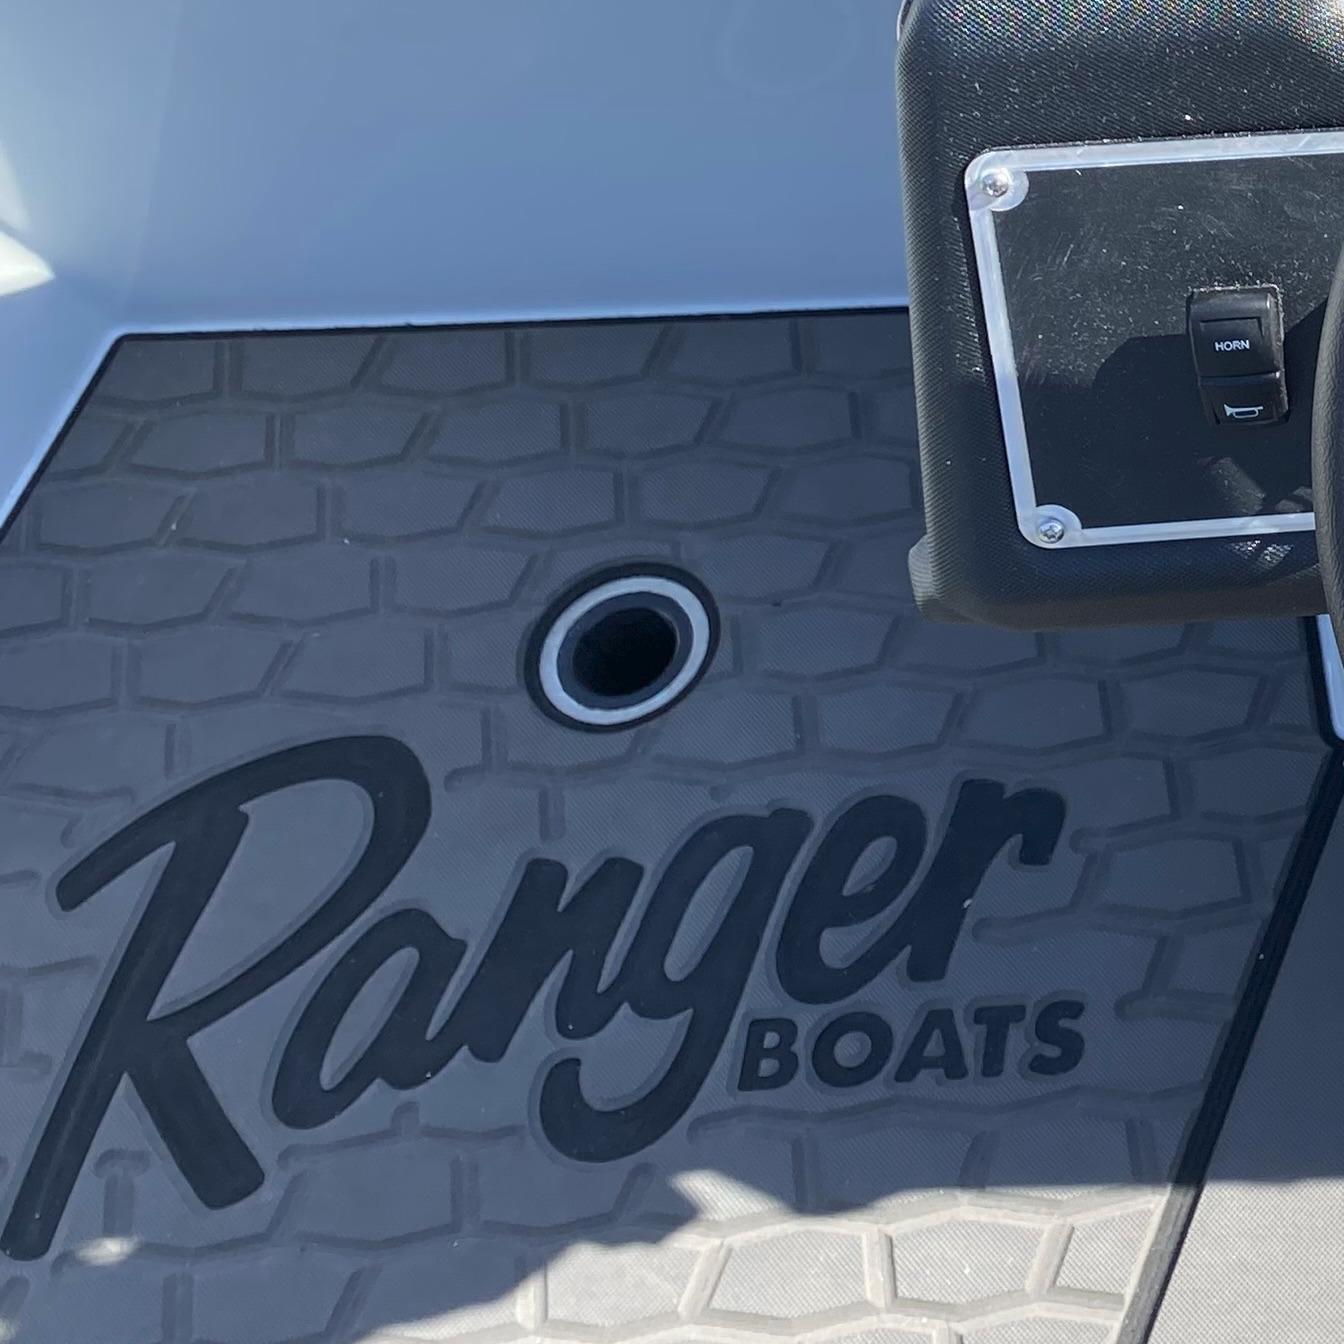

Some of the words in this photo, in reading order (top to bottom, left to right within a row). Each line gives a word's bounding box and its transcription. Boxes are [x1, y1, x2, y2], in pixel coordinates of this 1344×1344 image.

[1214, 338, 1250, 352] HORN
[1, 735, 1068, 1261] Ranger
[737, 1000, 1086, 1092] BOATS
